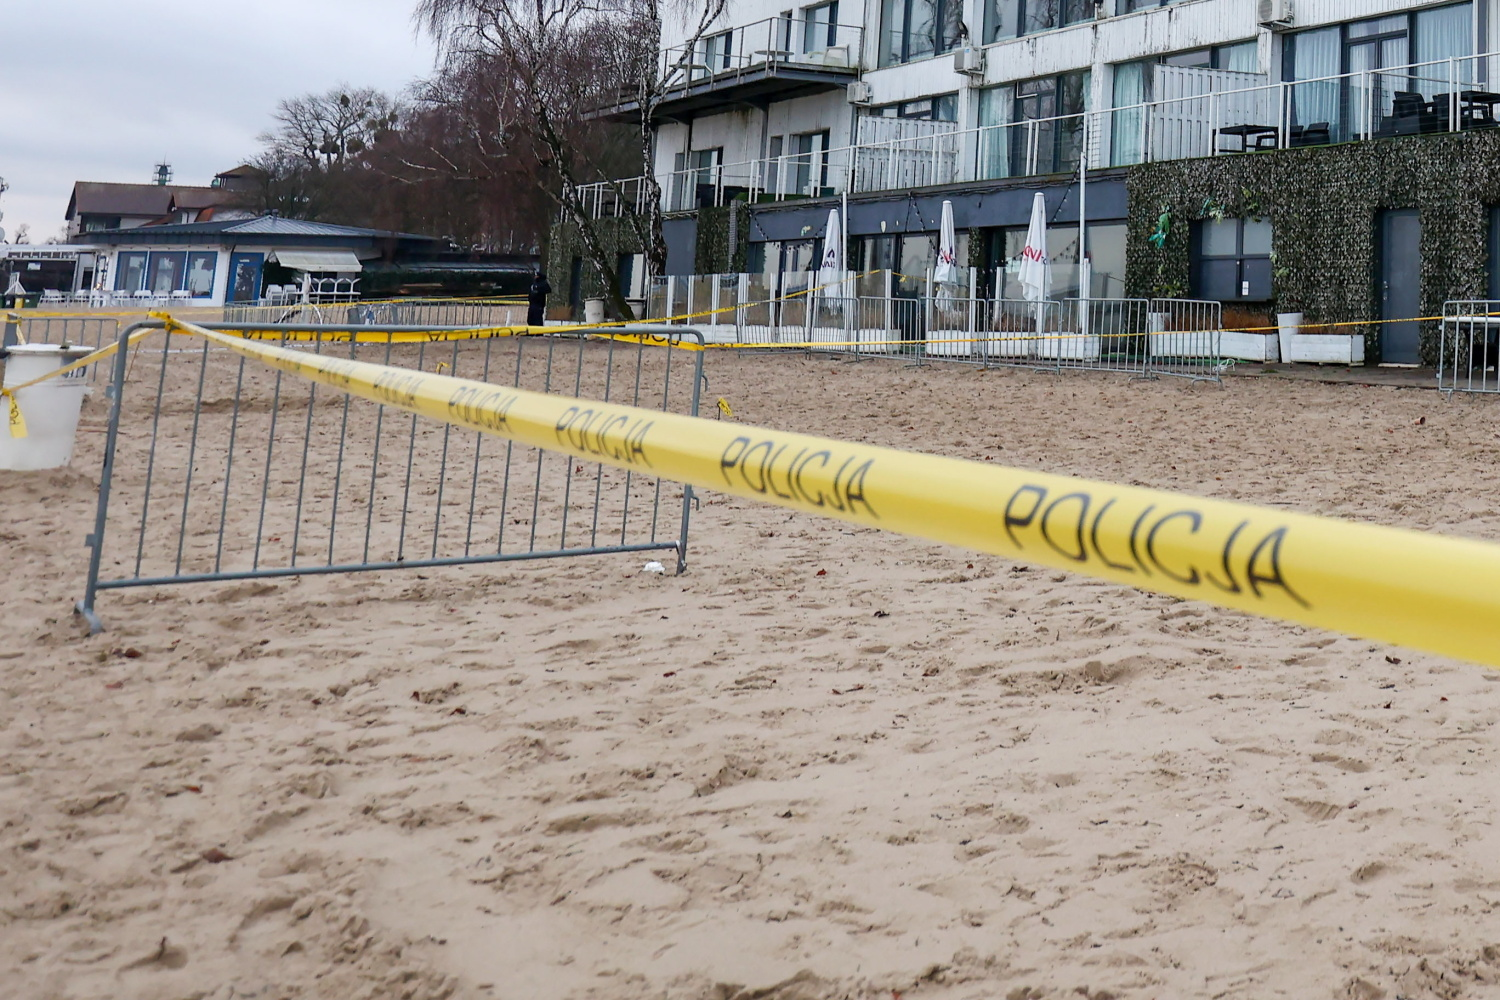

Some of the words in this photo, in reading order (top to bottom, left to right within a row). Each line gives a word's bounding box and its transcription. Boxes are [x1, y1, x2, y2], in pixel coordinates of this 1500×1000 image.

[449, 386, 516, 434] POLICJA
[555, 406, 653, 469] POLICJA
[721, 436, 881, 520] POLICJA
[1003, 484, 1314, 609] POLICJA
